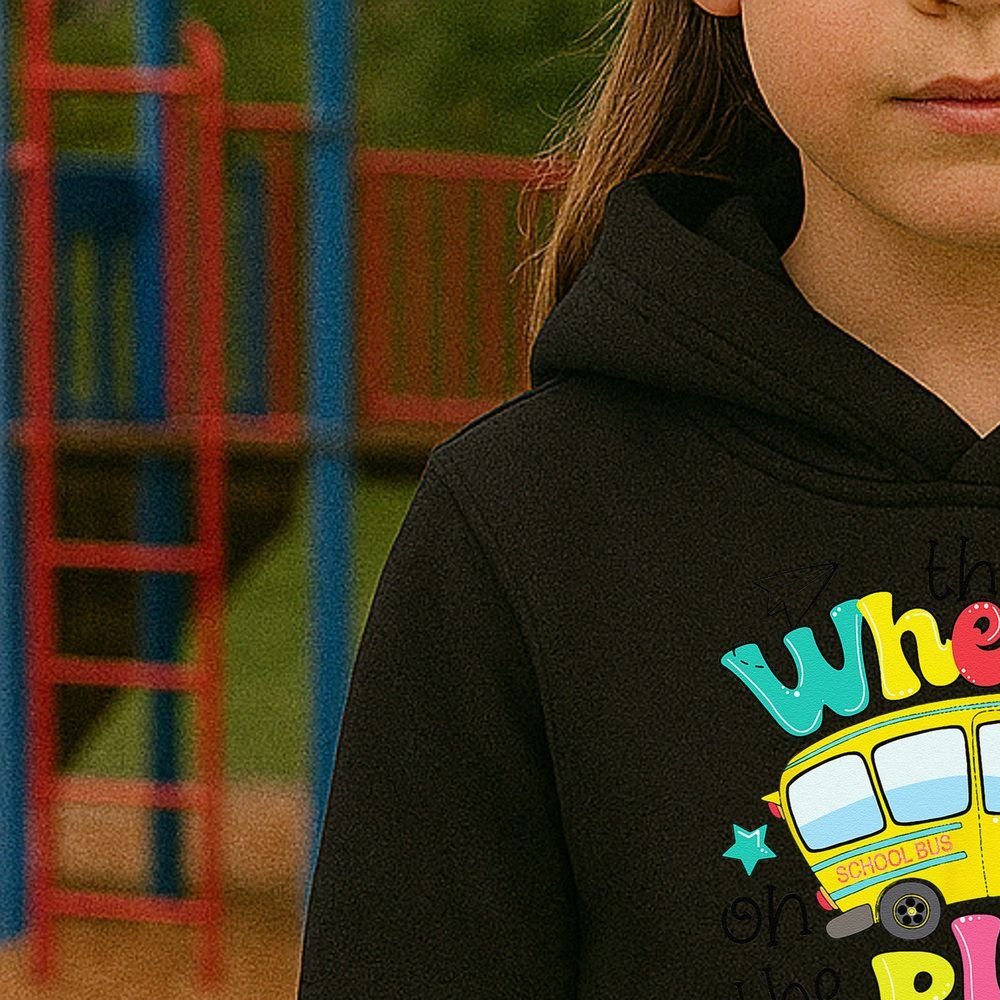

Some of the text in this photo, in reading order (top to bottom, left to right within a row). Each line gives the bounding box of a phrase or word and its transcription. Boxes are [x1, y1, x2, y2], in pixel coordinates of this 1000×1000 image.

[835, 834, 954, 883] SCHOOL BUS
[721, 884, 812, 948] on
